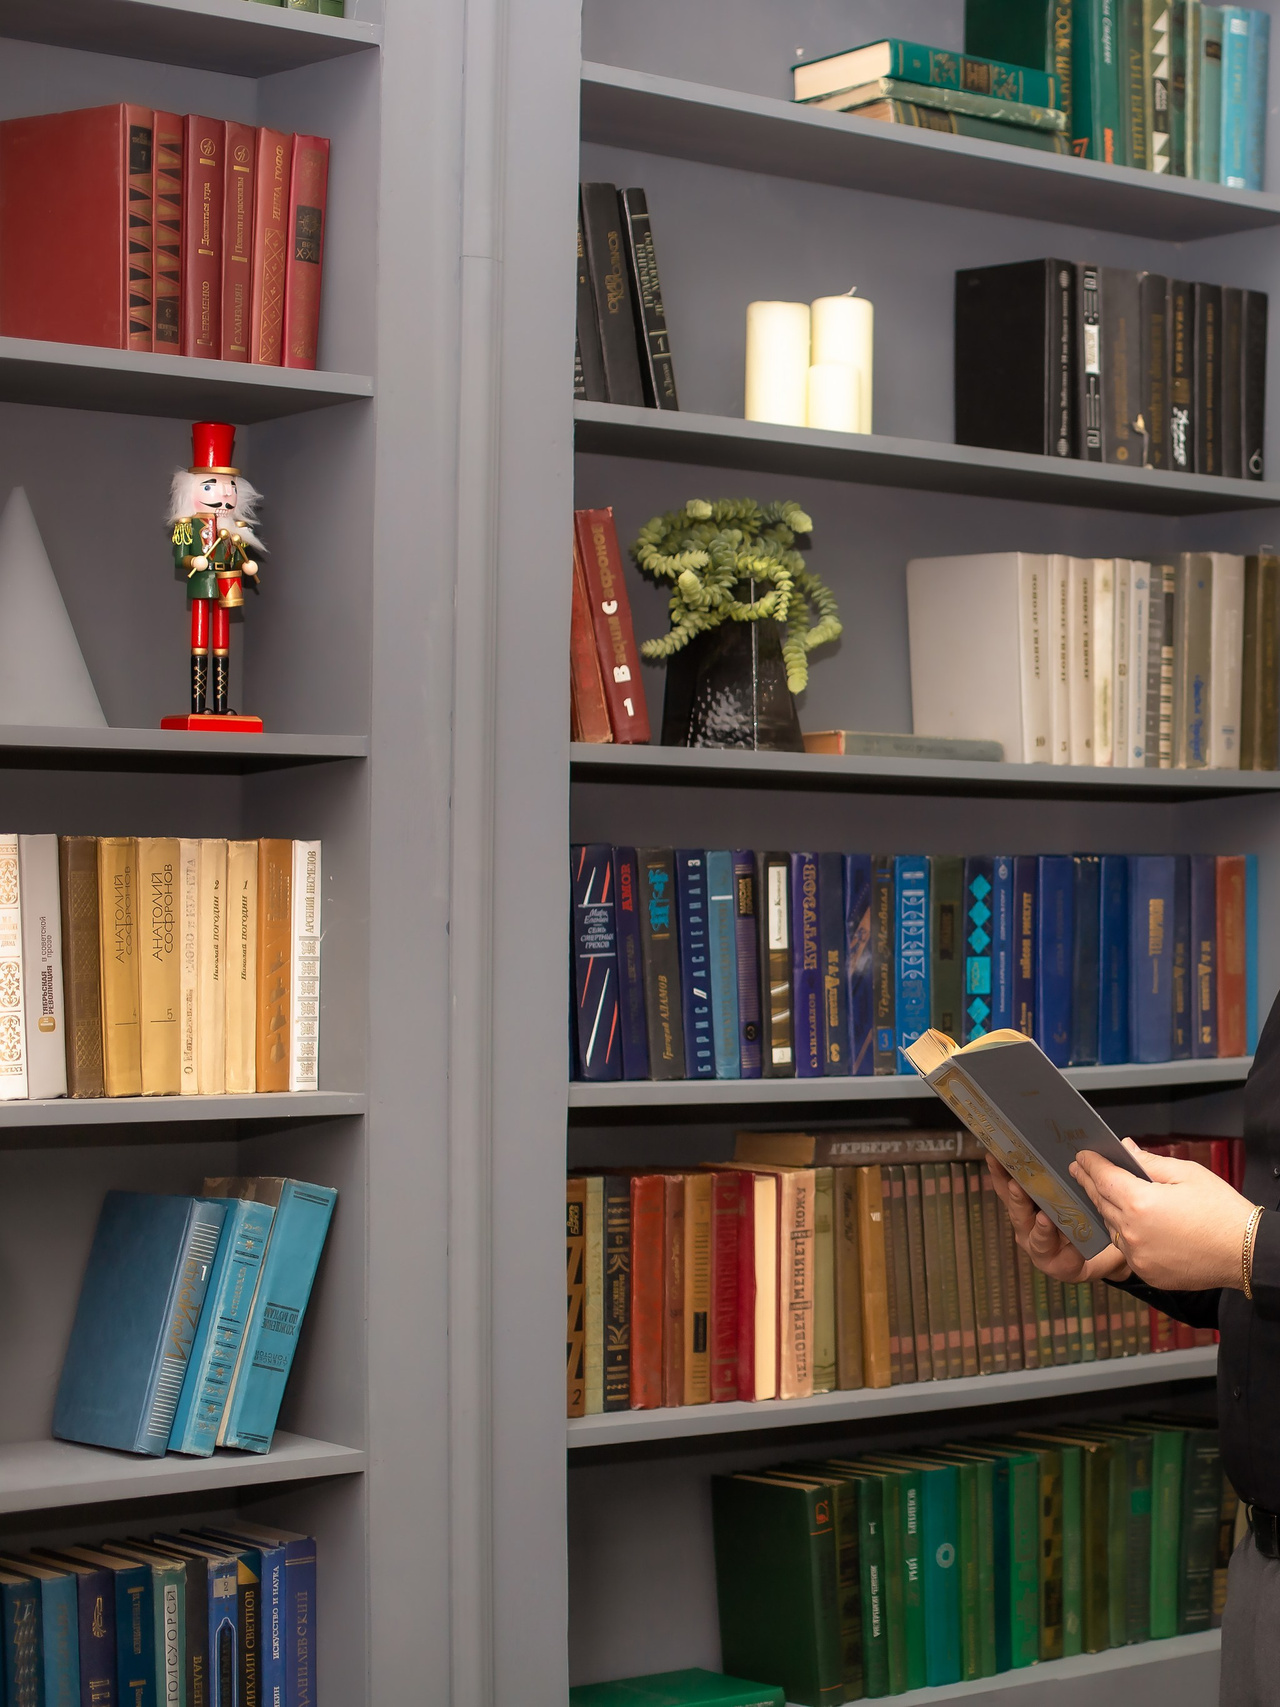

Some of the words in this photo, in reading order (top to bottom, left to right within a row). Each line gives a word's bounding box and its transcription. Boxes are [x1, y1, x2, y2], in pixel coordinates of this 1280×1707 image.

[273, 145, 284, 182] ГОФФ
[607, 616, 632, 684] Вадим
[623, 696, 634, 717] 1
[305, 851, 316, 894] НЕСМЕЛОВ
[621, 863, 633, 912] AMOR
[114, 874, 124, 963] АНАТОЛИЙ
[123, 866, 133, 955] СОФРОНОВ
[151, 872, 163, 962] АНАТОЛИЙ
[163, 864, 175, 953] СОФРОНОВ
[304, 896, 315, 933] АРСЕНИЙ
[803, 864, 817, 971] КУТУЗОВ
[166, 1008, 173, 1020] 5
[657, 974, 669, 1021] АДАМОВ
[695, 1006, 712, 1072] БОРИС
[829, 1138, 901, 1155] ГЕРБЕРТ
[795, 1187, 806, 1229] КОЖУ
[201, 1265, 207, 1281] 1
[793, 1239, 806, 1300] МЕНЯЕТ
[796, 1310, 807, 1383] ЧЕЛОВЕК
[572, 1389, 581, 1406] 2
[223, 1581, 229, 1591] 2
[272, 1566, 280, 1596] НАУКА
[245, 1591, 255, 1649] СВЕТЛОВ
[272, 1608, 280, 1659] ИСКУССТВО
[166, 1589, 178, 1702] ГОЛСУОРСИ
